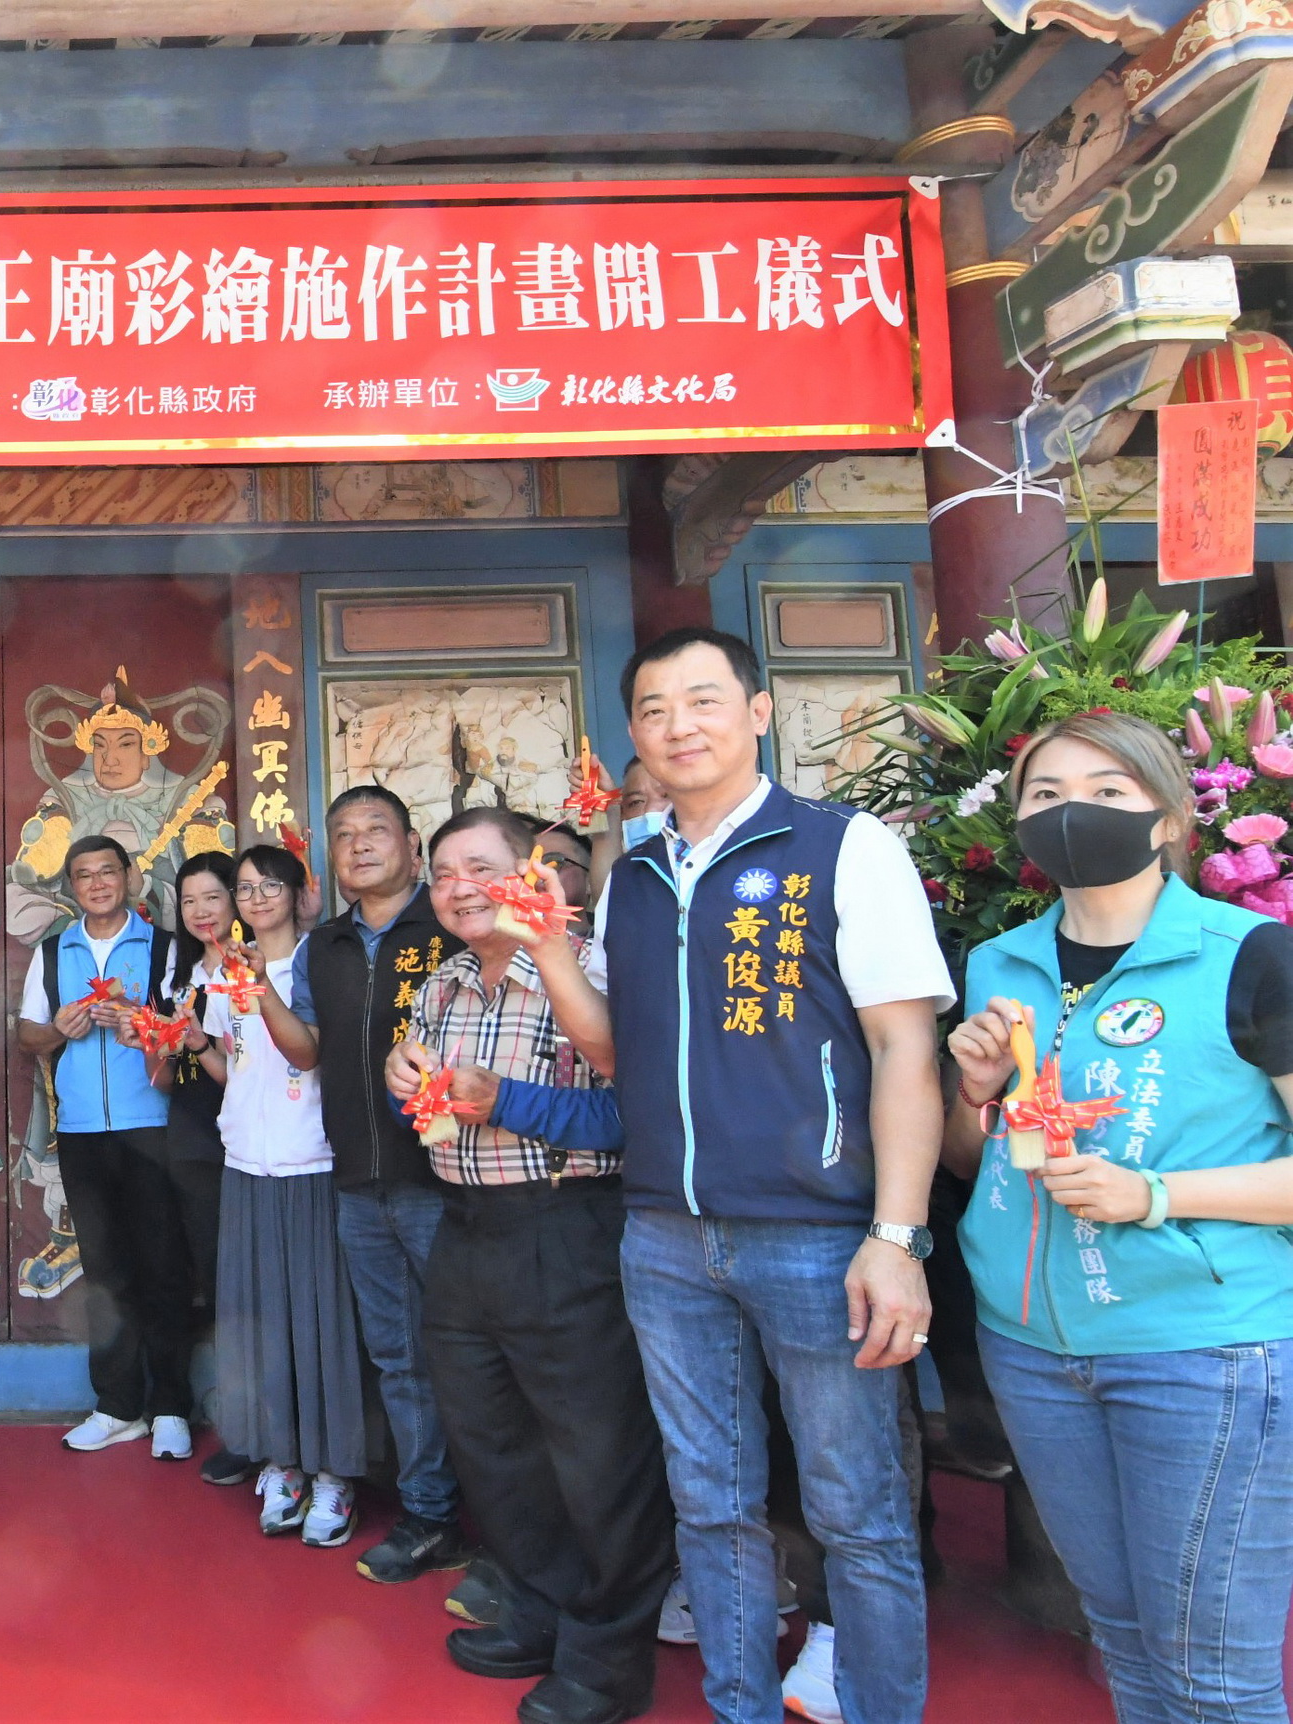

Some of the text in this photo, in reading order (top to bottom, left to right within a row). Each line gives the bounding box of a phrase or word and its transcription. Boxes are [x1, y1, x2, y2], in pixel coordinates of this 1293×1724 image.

[90, 384, 257, 416] 彰化縣政府
[560, 372, 737, 407] 彰化縣文化局
[1226, 410, 1248, 432] 祝
[1191, 426, 1214, 553] 圓滿成功
[723, 906, 771, 1037] 黃俊源
[774, 873, 813, 1023] 彰化縣議員
[1124, 1048, 1167, 1165] 立法委員
